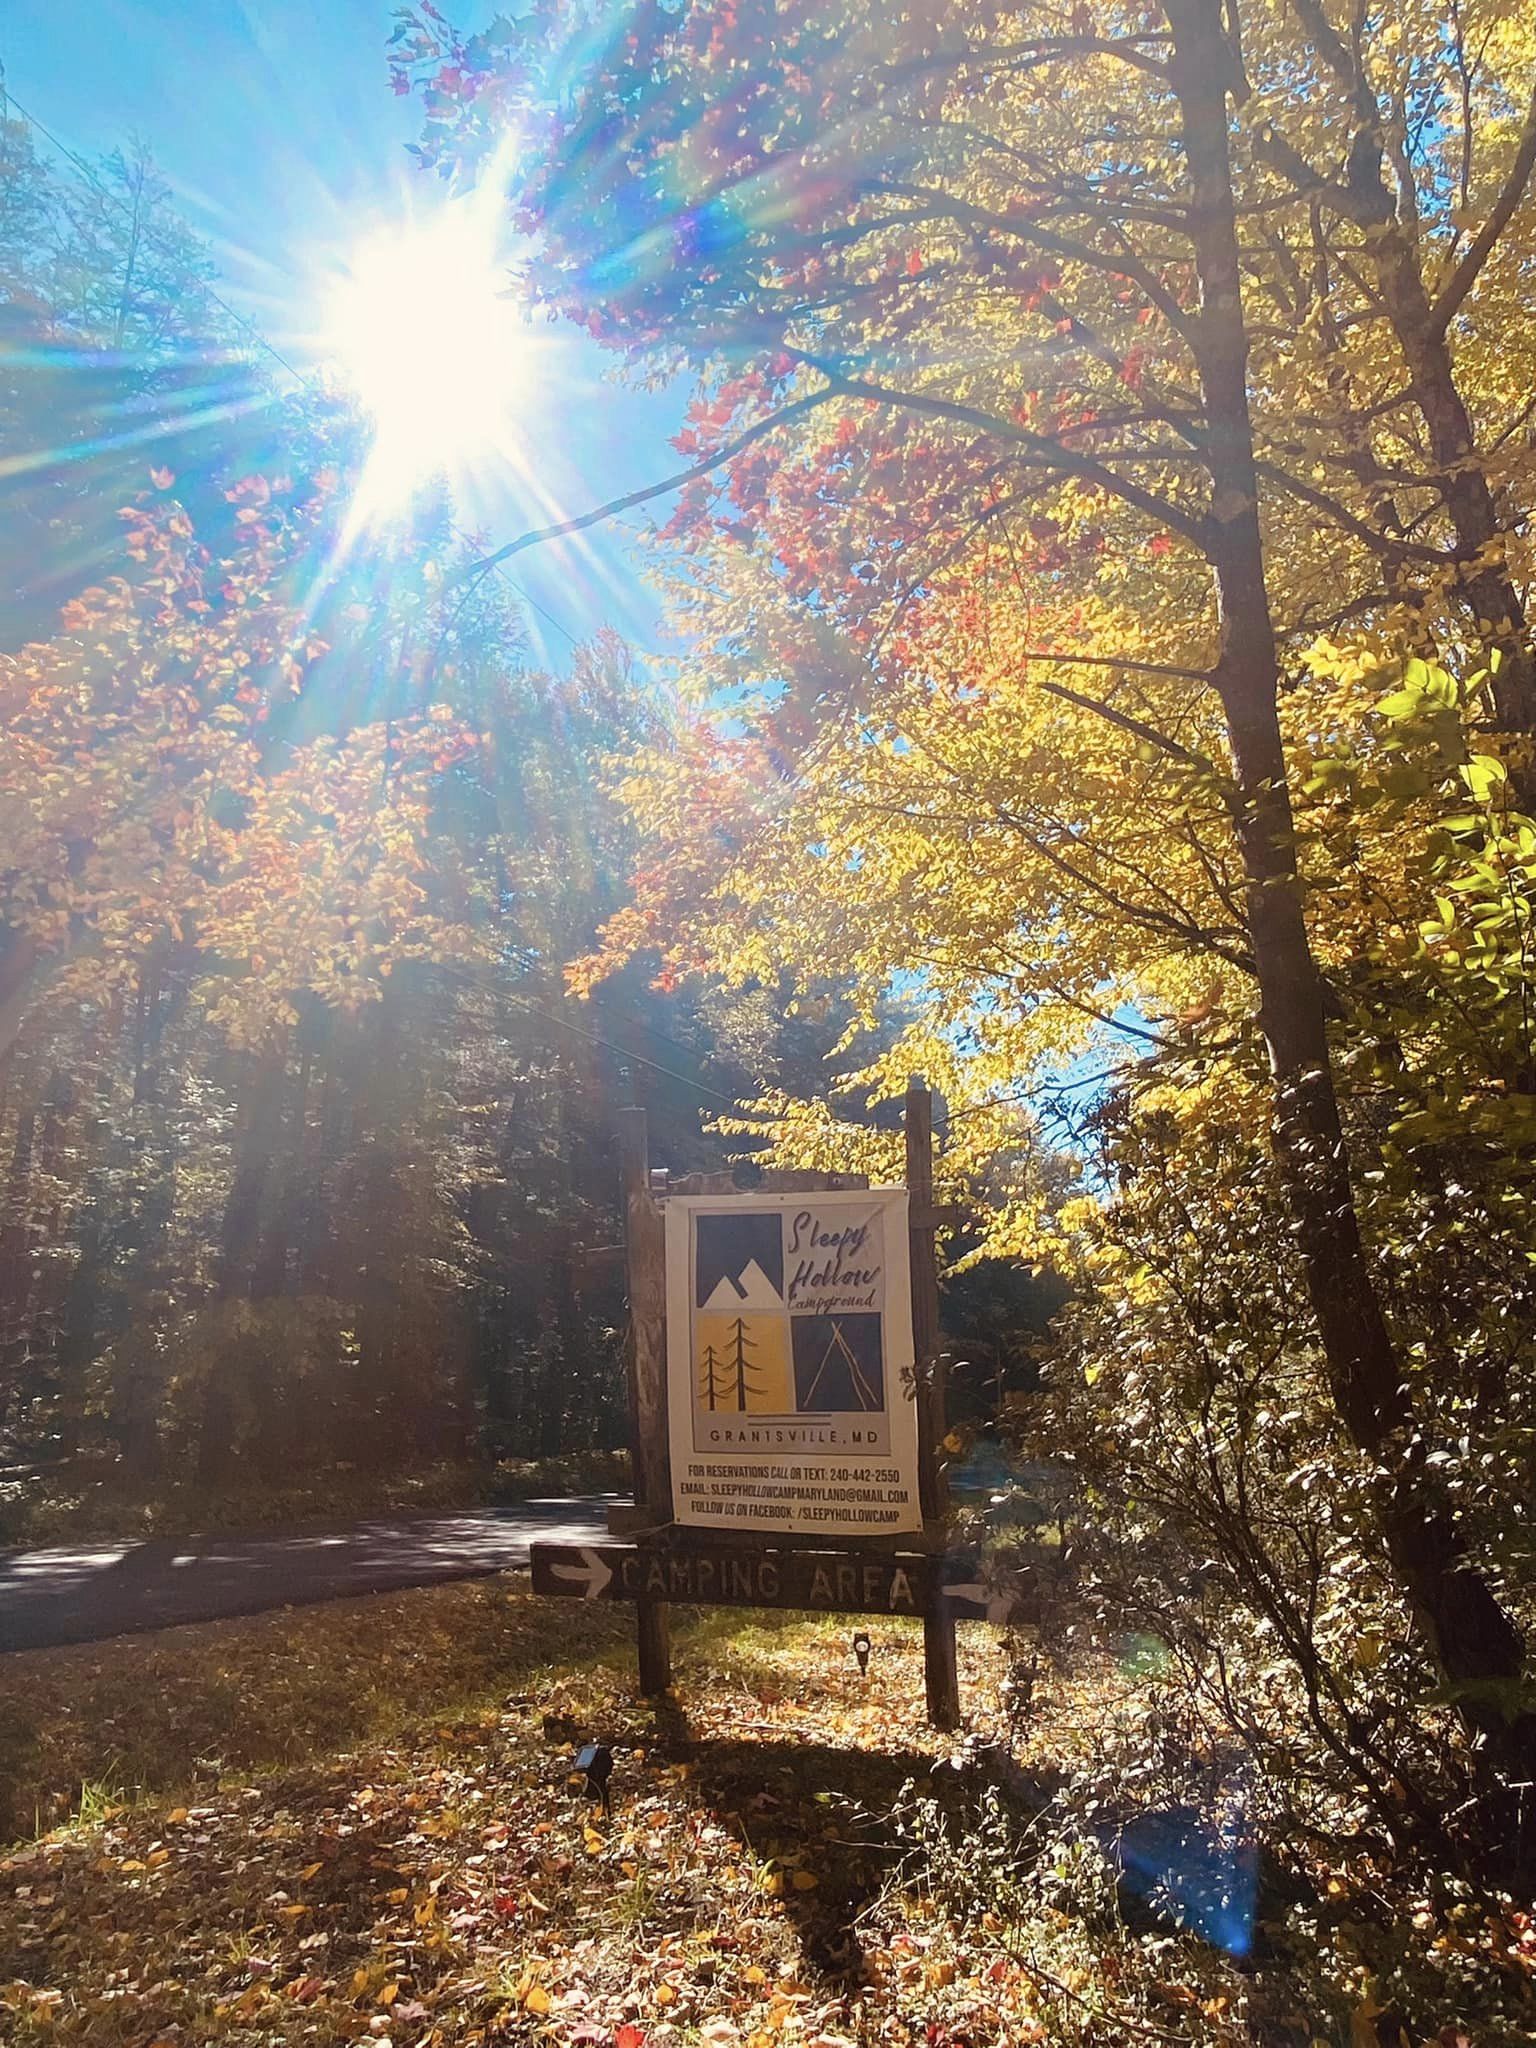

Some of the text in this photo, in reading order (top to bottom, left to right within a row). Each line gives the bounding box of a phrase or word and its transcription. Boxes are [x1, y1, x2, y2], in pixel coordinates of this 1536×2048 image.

[788, 1211, 868, 1256] Sleepy
[788, 1260, 880, 1301] Hollow
[787, 1289, 876, 1315] Campground
[688, 1465, 900, 1483] FOR RESERVATIONS CALL OR TEXT: 240-442-2550
[680, 1483, 909, 1503] EMAIL: SLEEPYHOLLOWCAMPMARYLAND@GMAIL.COM
[691, 1501, 900, 1523] FOLLOW US ON FACEBOOK: /SLEEPYHOLLOWCAMP
[621, 1556, 780, 1599] CAMPING
